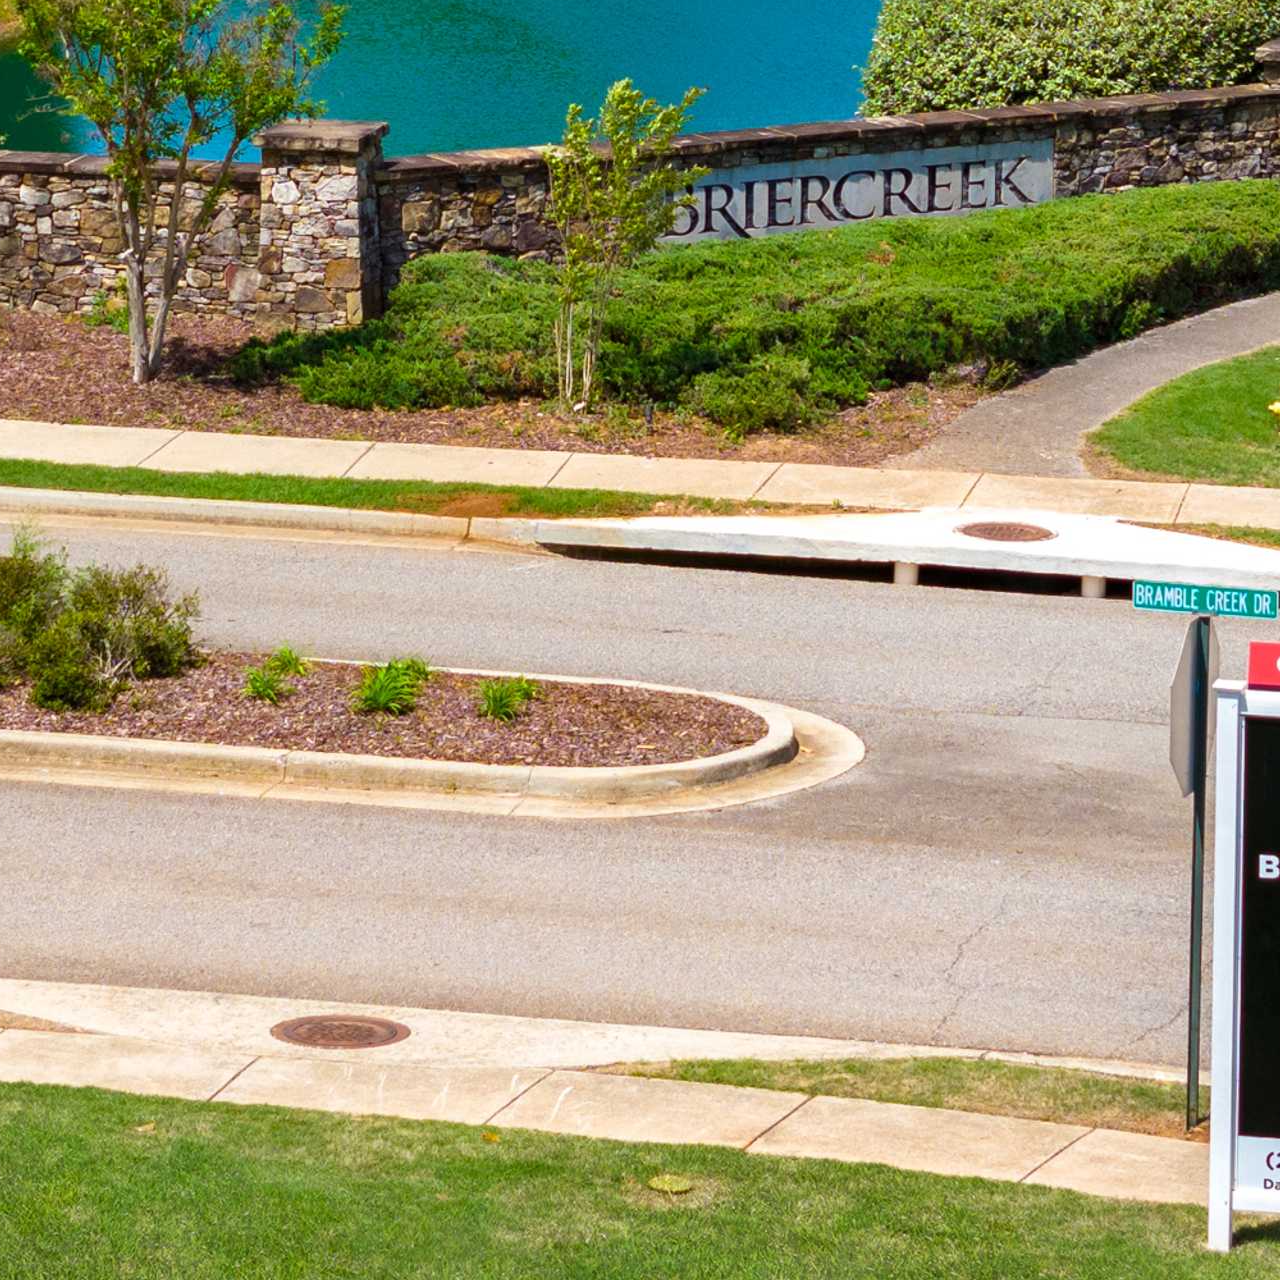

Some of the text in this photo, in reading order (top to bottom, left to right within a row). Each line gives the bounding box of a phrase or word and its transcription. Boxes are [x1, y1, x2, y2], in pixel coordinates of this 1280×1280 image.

[1135, 585, 1275, 615] BRAMBLE CREEK DR.
